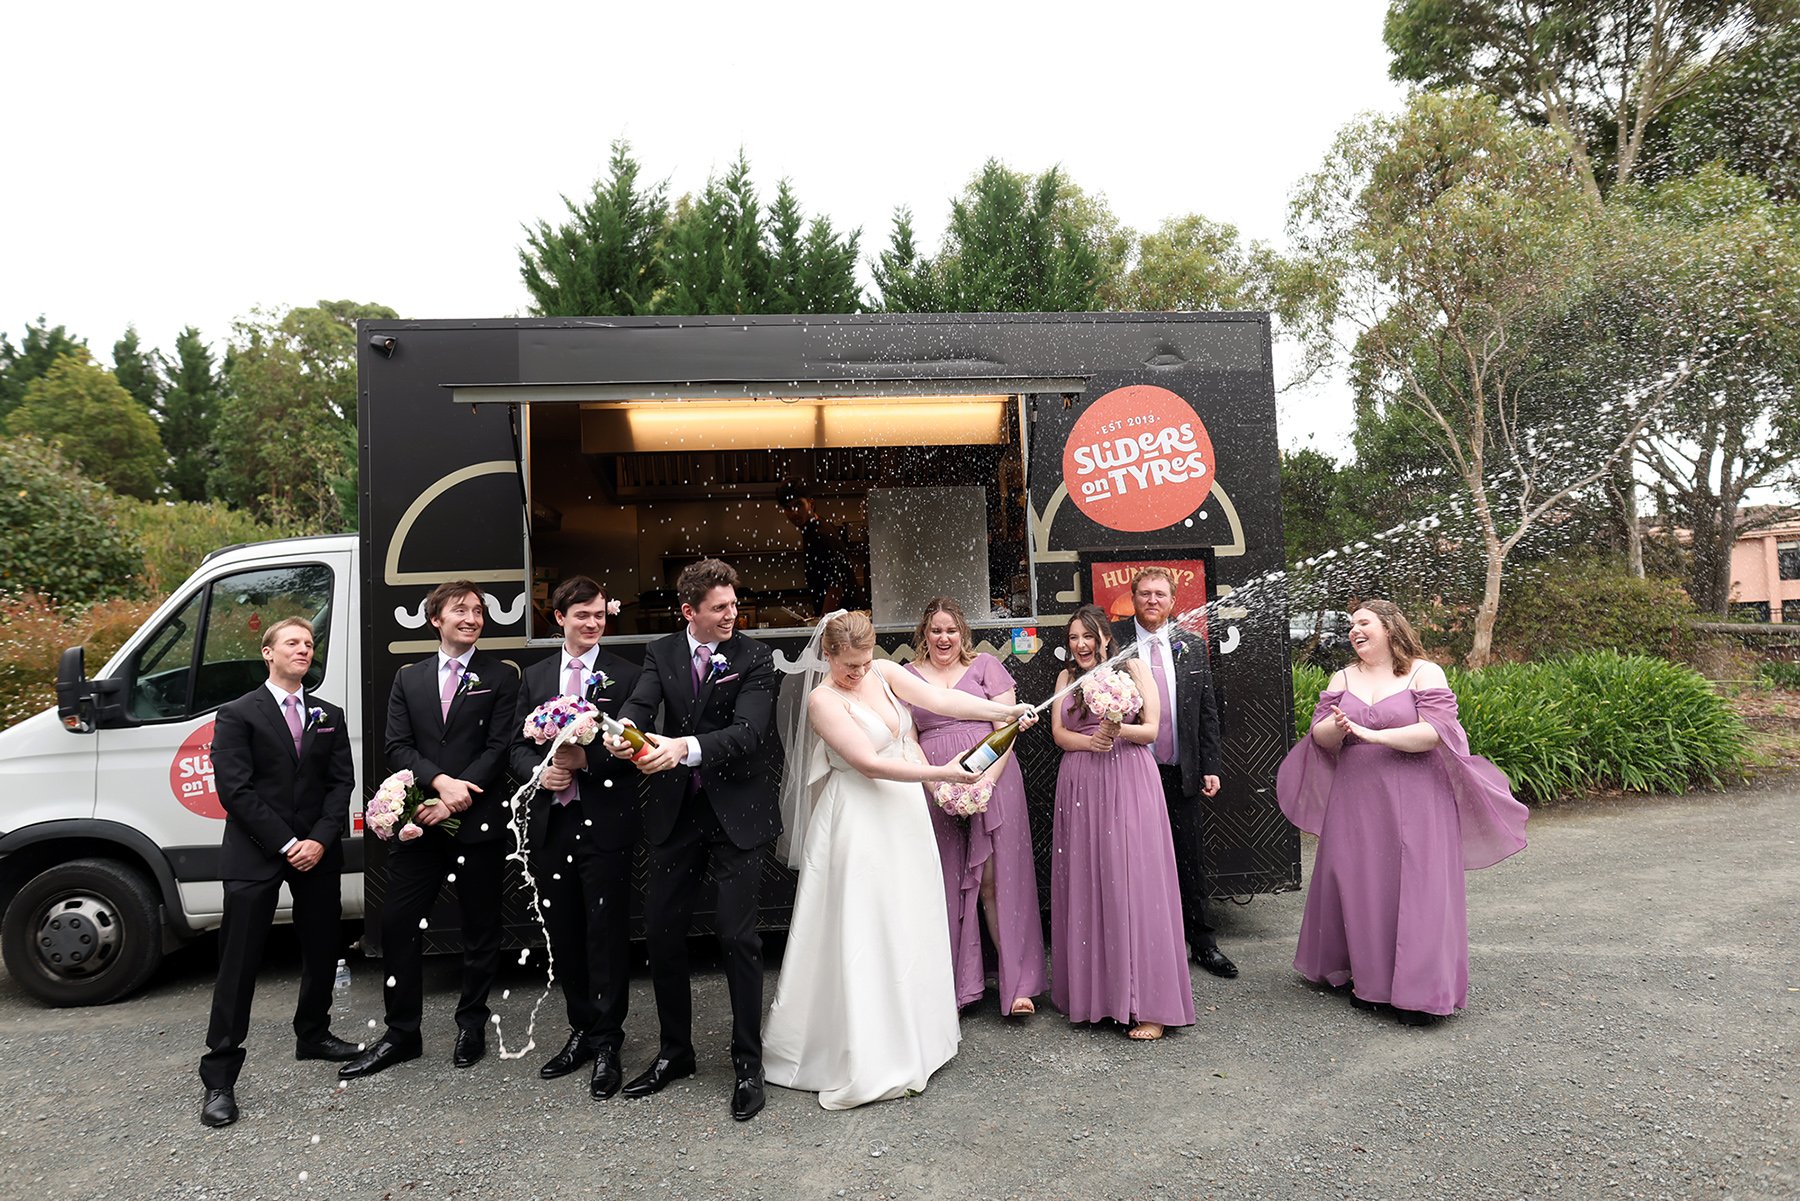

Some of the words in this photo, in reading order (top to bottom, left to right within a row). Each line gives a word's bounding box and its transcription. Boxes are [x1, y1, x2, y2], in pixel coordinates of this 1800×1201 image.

[1101, 420, 1122, 434] EST
[1127, 414, 1155, 427] 2013
[1081, 478, 1111, 496] on
